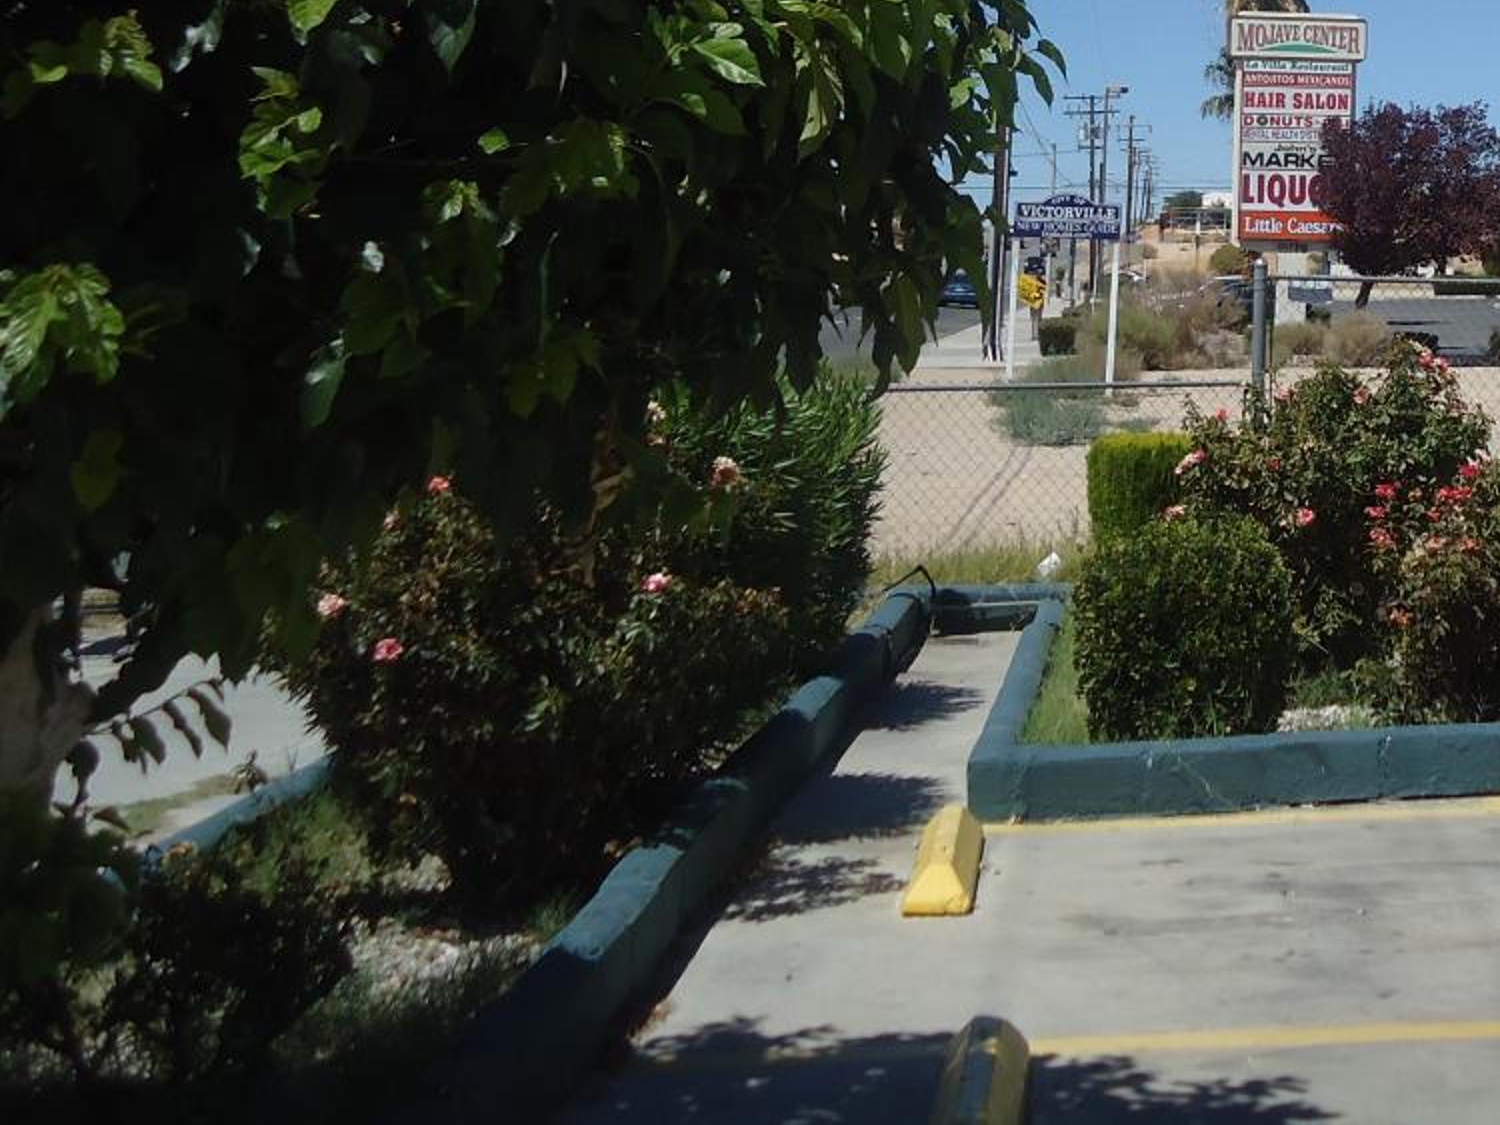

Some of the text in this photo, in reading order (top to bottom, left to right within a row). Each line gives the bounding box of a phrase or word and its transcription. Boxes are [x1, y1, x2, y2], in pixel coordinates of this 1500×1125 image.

[1237, 22, 1361, 54] MOJAVE CENTER
[1245, 92, 1348, 110] HAIR SALON
[1244, 116, 1312, 127] DONUTS
[1243, 152, 1336, 168] MARKE
[1021, 204, 1117, 219] VICTORVILLE
[1244, 217, 1283, 233] Little
